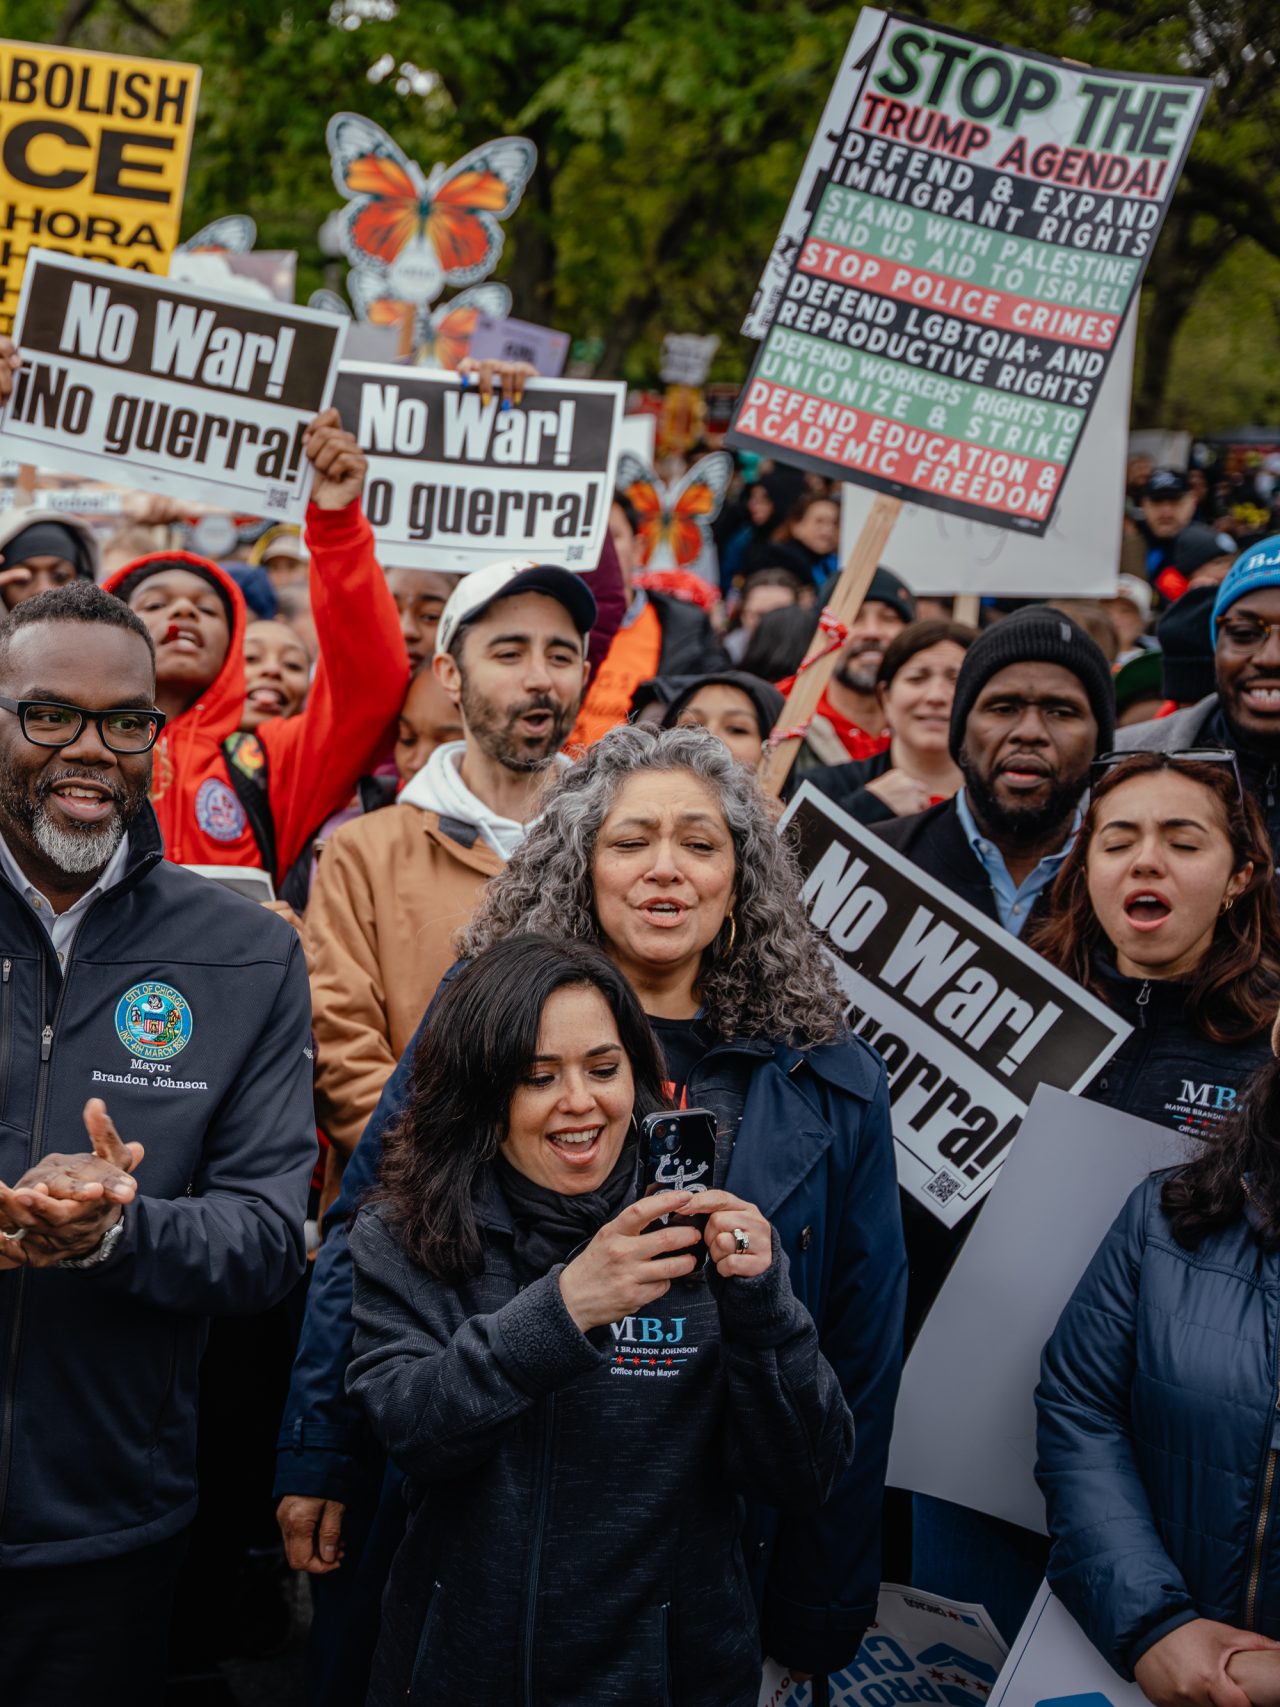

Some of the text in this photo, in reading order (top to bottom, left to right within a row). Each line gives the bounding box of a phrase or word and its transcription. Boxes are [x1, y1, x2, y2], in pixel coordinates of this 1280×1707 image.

[876, 29, 1195, 156] STOP THE
[842, 132, 1160, 230] DEFEND & EXPAND
[863, 92, 1169, 198] TRUMP AGENDA!
[827, 190, 1135, 287] STAND WITH PALESTINE
[832, 158, 1151, 257] IMMIGRANT RIGHTS
[802, 243, 1116, 345] STOP POLICE CRIMES
[816, 214, 1120, 312] END US AID TO ISRAEL
[59, 280, 296, 399] No War!
[776, 300, 990, 384] REPRODUCTIVE
[996, 367, 1093, 406] RIGHTS
[787, 272, 897, 325] DEFEND
[904, 307, 1042, 363] LGBTQIA+
[1047, 349, 1104, 379] AND
[358, 382, 576, 466] No War!
[760, 354, 1070, 461] UNIONIZE & STRIKE
[769, 330, 1080, 434] DEFEND WORKERS' RIGHTS TO
[103, 392, 310, 482] guerra!
[738, 408, 1052, 517] ACADEMIC FREEDOM
[749, 382, 1057, 490] DEFEND EDUCATION &
[408, 481, 600, 541] guerra!
[126, 985, 185, 1010] CITY OF CHICAGO
[802, 840, 1064, 1077] No War!
[91, 1070, 208, 1089] Brandon Johnson
[130, 1059, 171, 1073] Mayor
[144, 1046, 174, 1057] MARCH
[847, 1003, 1024, 1181] uerra!
[1176, 1079, 1244, 1112] MB
[1164, 1103, 1191, 1114] MAYOR
[610, 1316, 687, 1343] MBJ
[610, 1367, 680, 1378] Office of the Mayor
[620, 1346, 698, 1355] BRANDON JOHNSON
